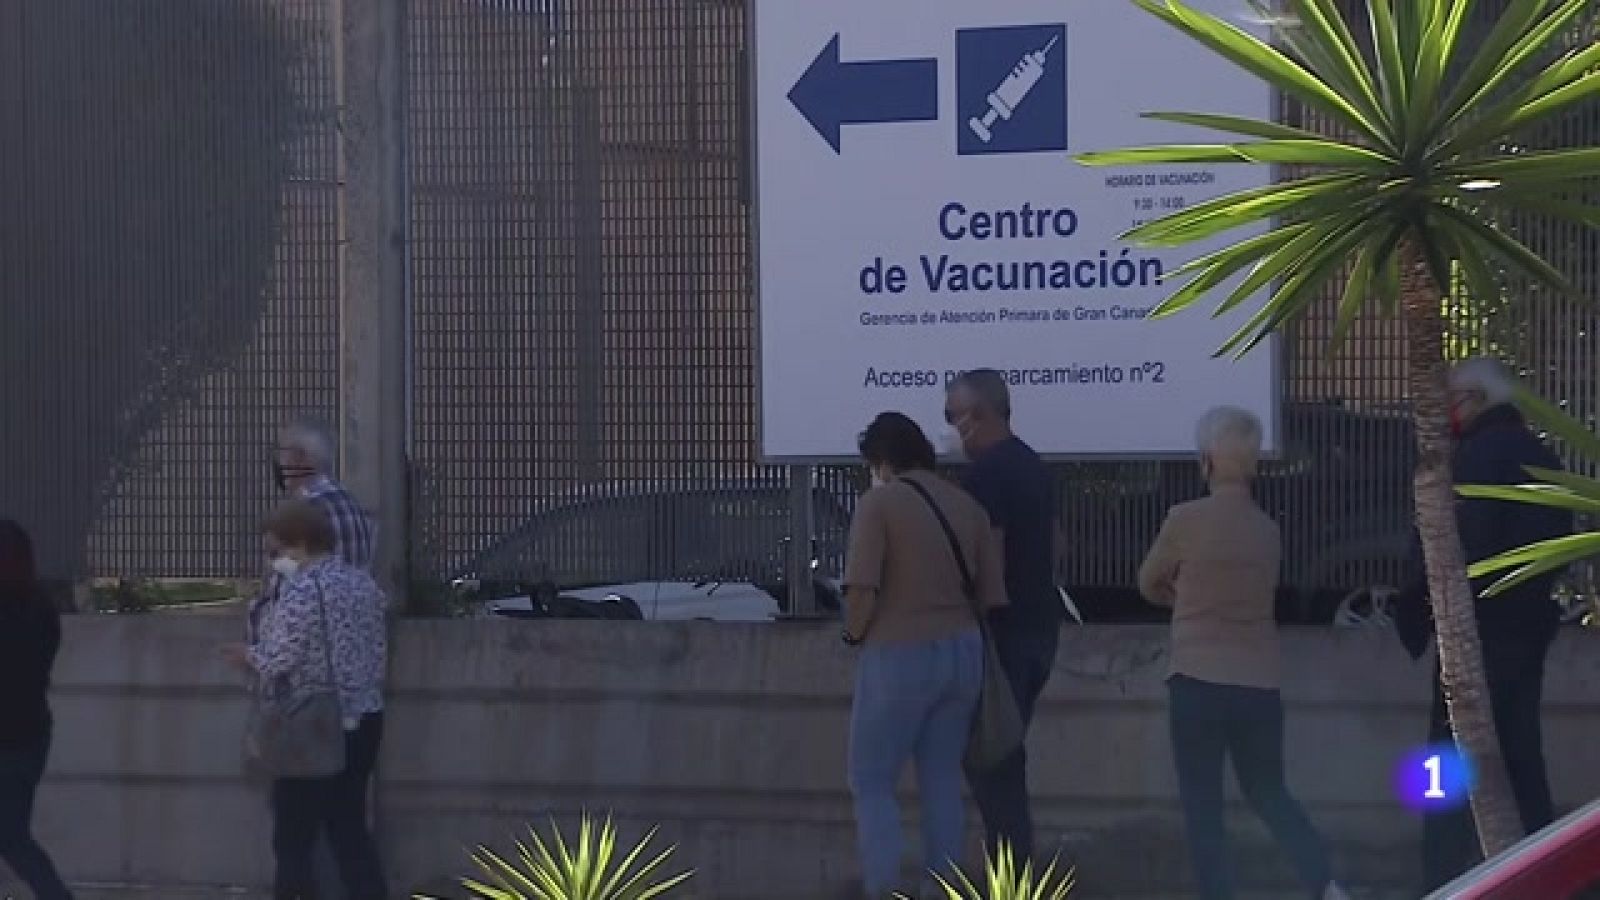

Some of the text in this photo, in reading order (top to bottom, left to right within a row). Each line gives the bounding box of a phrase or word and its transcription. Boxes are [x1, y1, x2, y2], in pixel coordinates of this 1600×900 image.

[939, 202, 1078, 241] Centro
[859, 248, 1163, 294] de Vacunación
[860, 312, 917, 325] Gerencia
[920, 312, 936, 324] de
[939, 310, 996, 323] Atención
[1052, 308, 1070, 320] de
[1074, 306, 1106, 320] Gran
[864, 367, 938, 388] Acceso
[1001, 362, 1123, 385] arcamiento
